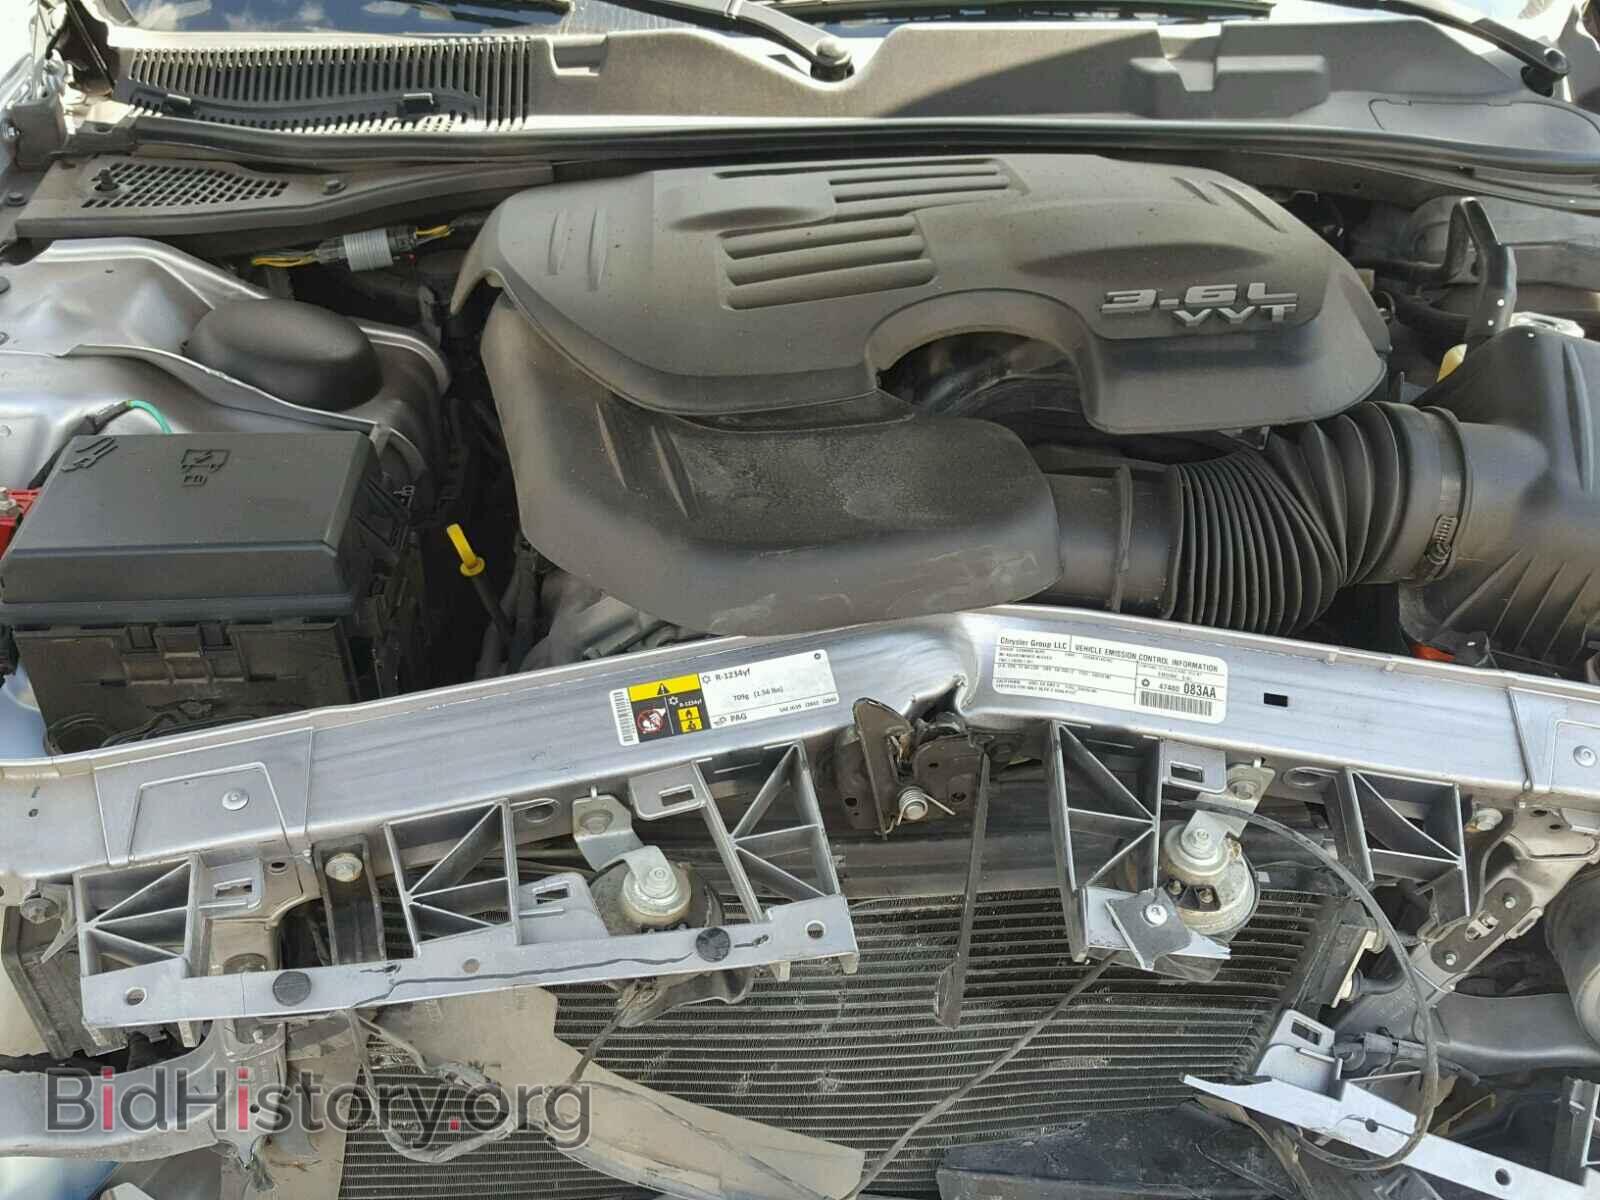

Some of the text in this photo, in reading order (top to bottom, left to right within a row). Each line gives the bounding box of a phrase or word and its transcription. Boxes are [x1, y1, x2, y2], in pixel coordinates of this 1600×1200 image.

[1172, 303, 1297, 327] VVT
[1000, 636, 1067, 650] Chrysler Group LLC
[1104, 648, 1137, 659] EMISSION
[1138, 654, 1168, 665] CONTROL
[1171, 659, 1218, 672] INFORMATION
[730, 714, 748, 722] PAG
